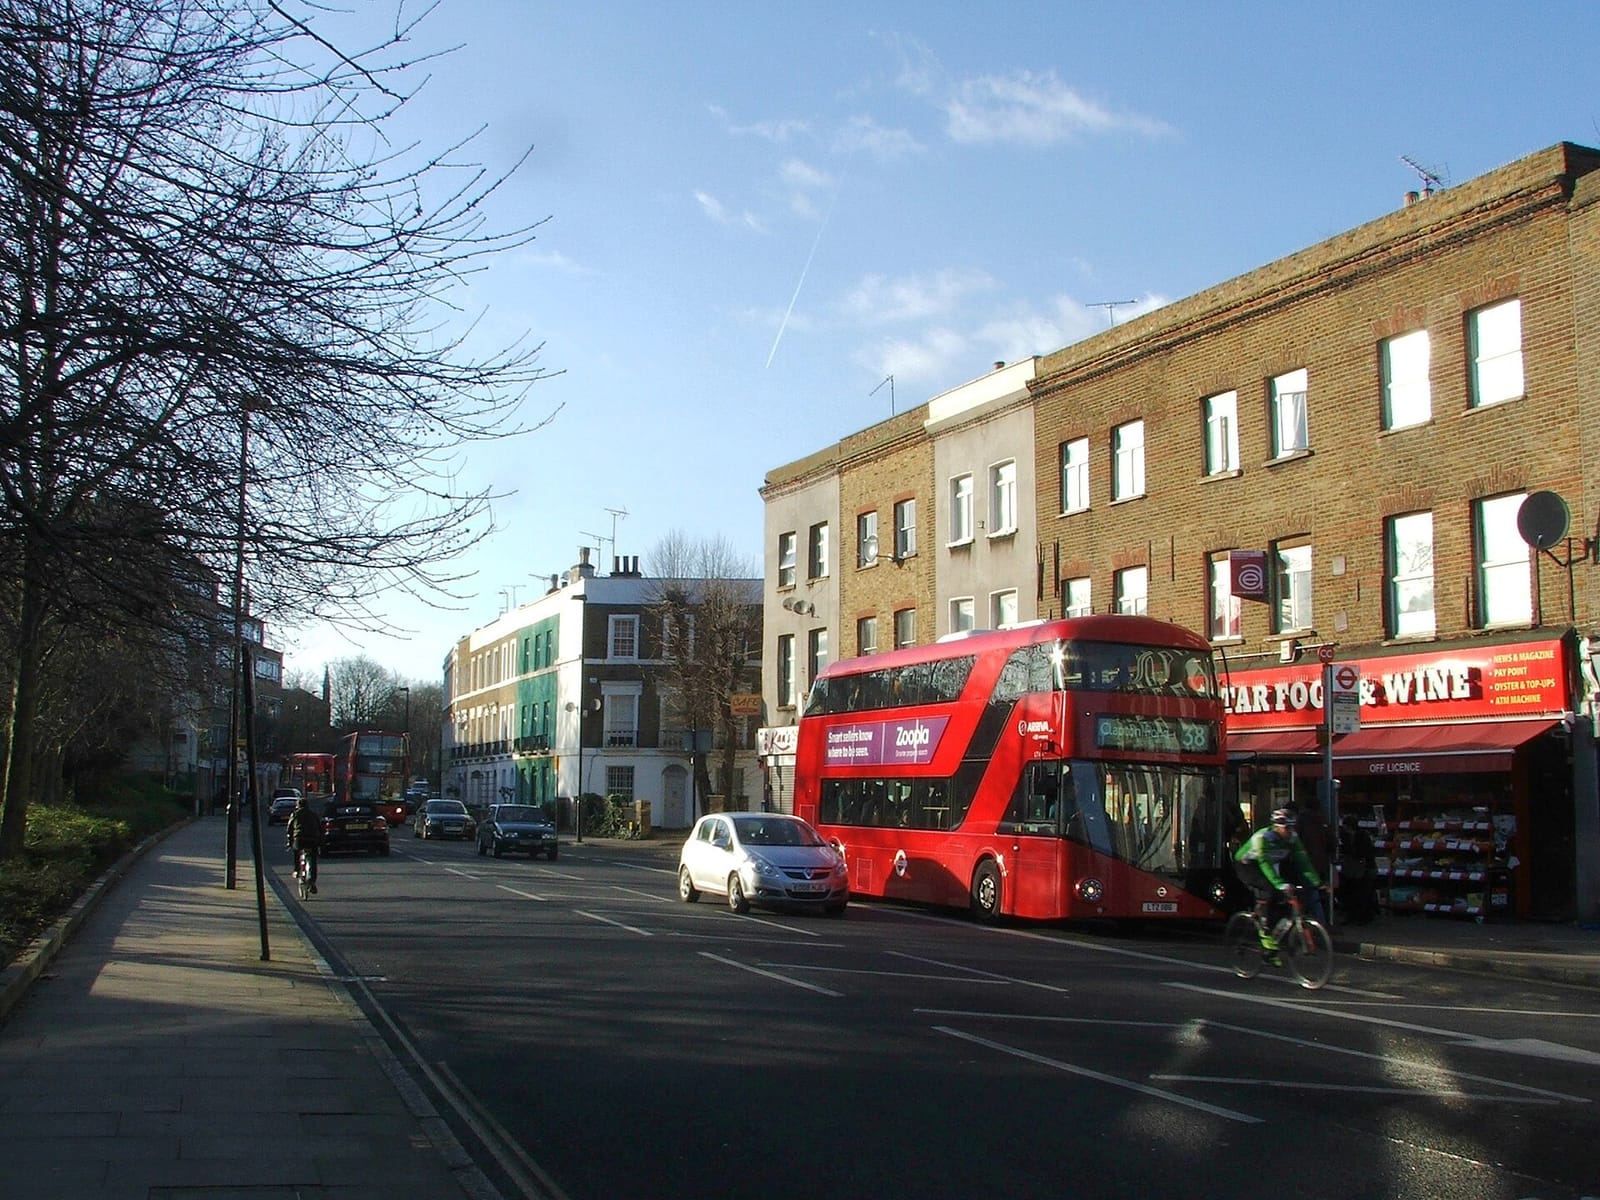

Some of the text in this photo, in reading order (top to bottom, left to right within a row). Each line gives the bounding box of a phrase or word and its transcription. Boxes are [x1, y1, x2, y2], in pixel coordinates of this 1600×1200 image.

[1320, 649, 1333, 658] CC
[1494, 650, 1554, 663] NEWS & MAGAZINE
[1494, 666, 1527, 677] PAY POINT
[1206, 665, 1471, 713] TAR FOO & WINE
[1494, 679, 1555, 691] OYSTER & TOP-UPS
[1510, 694, 1541, 704] MACHINE
[1027, 721, 1049, 732] ARRIVA
[828, 732, 843, 743] Smart
[859, 730, 873, 741] know
[896, 726, 929, 749] Zoopla
[1182, 726, 1205, 746] 38
[828, 746, 842, 758] where
[1369, 762, 1420, 773] OFF LICENCE
